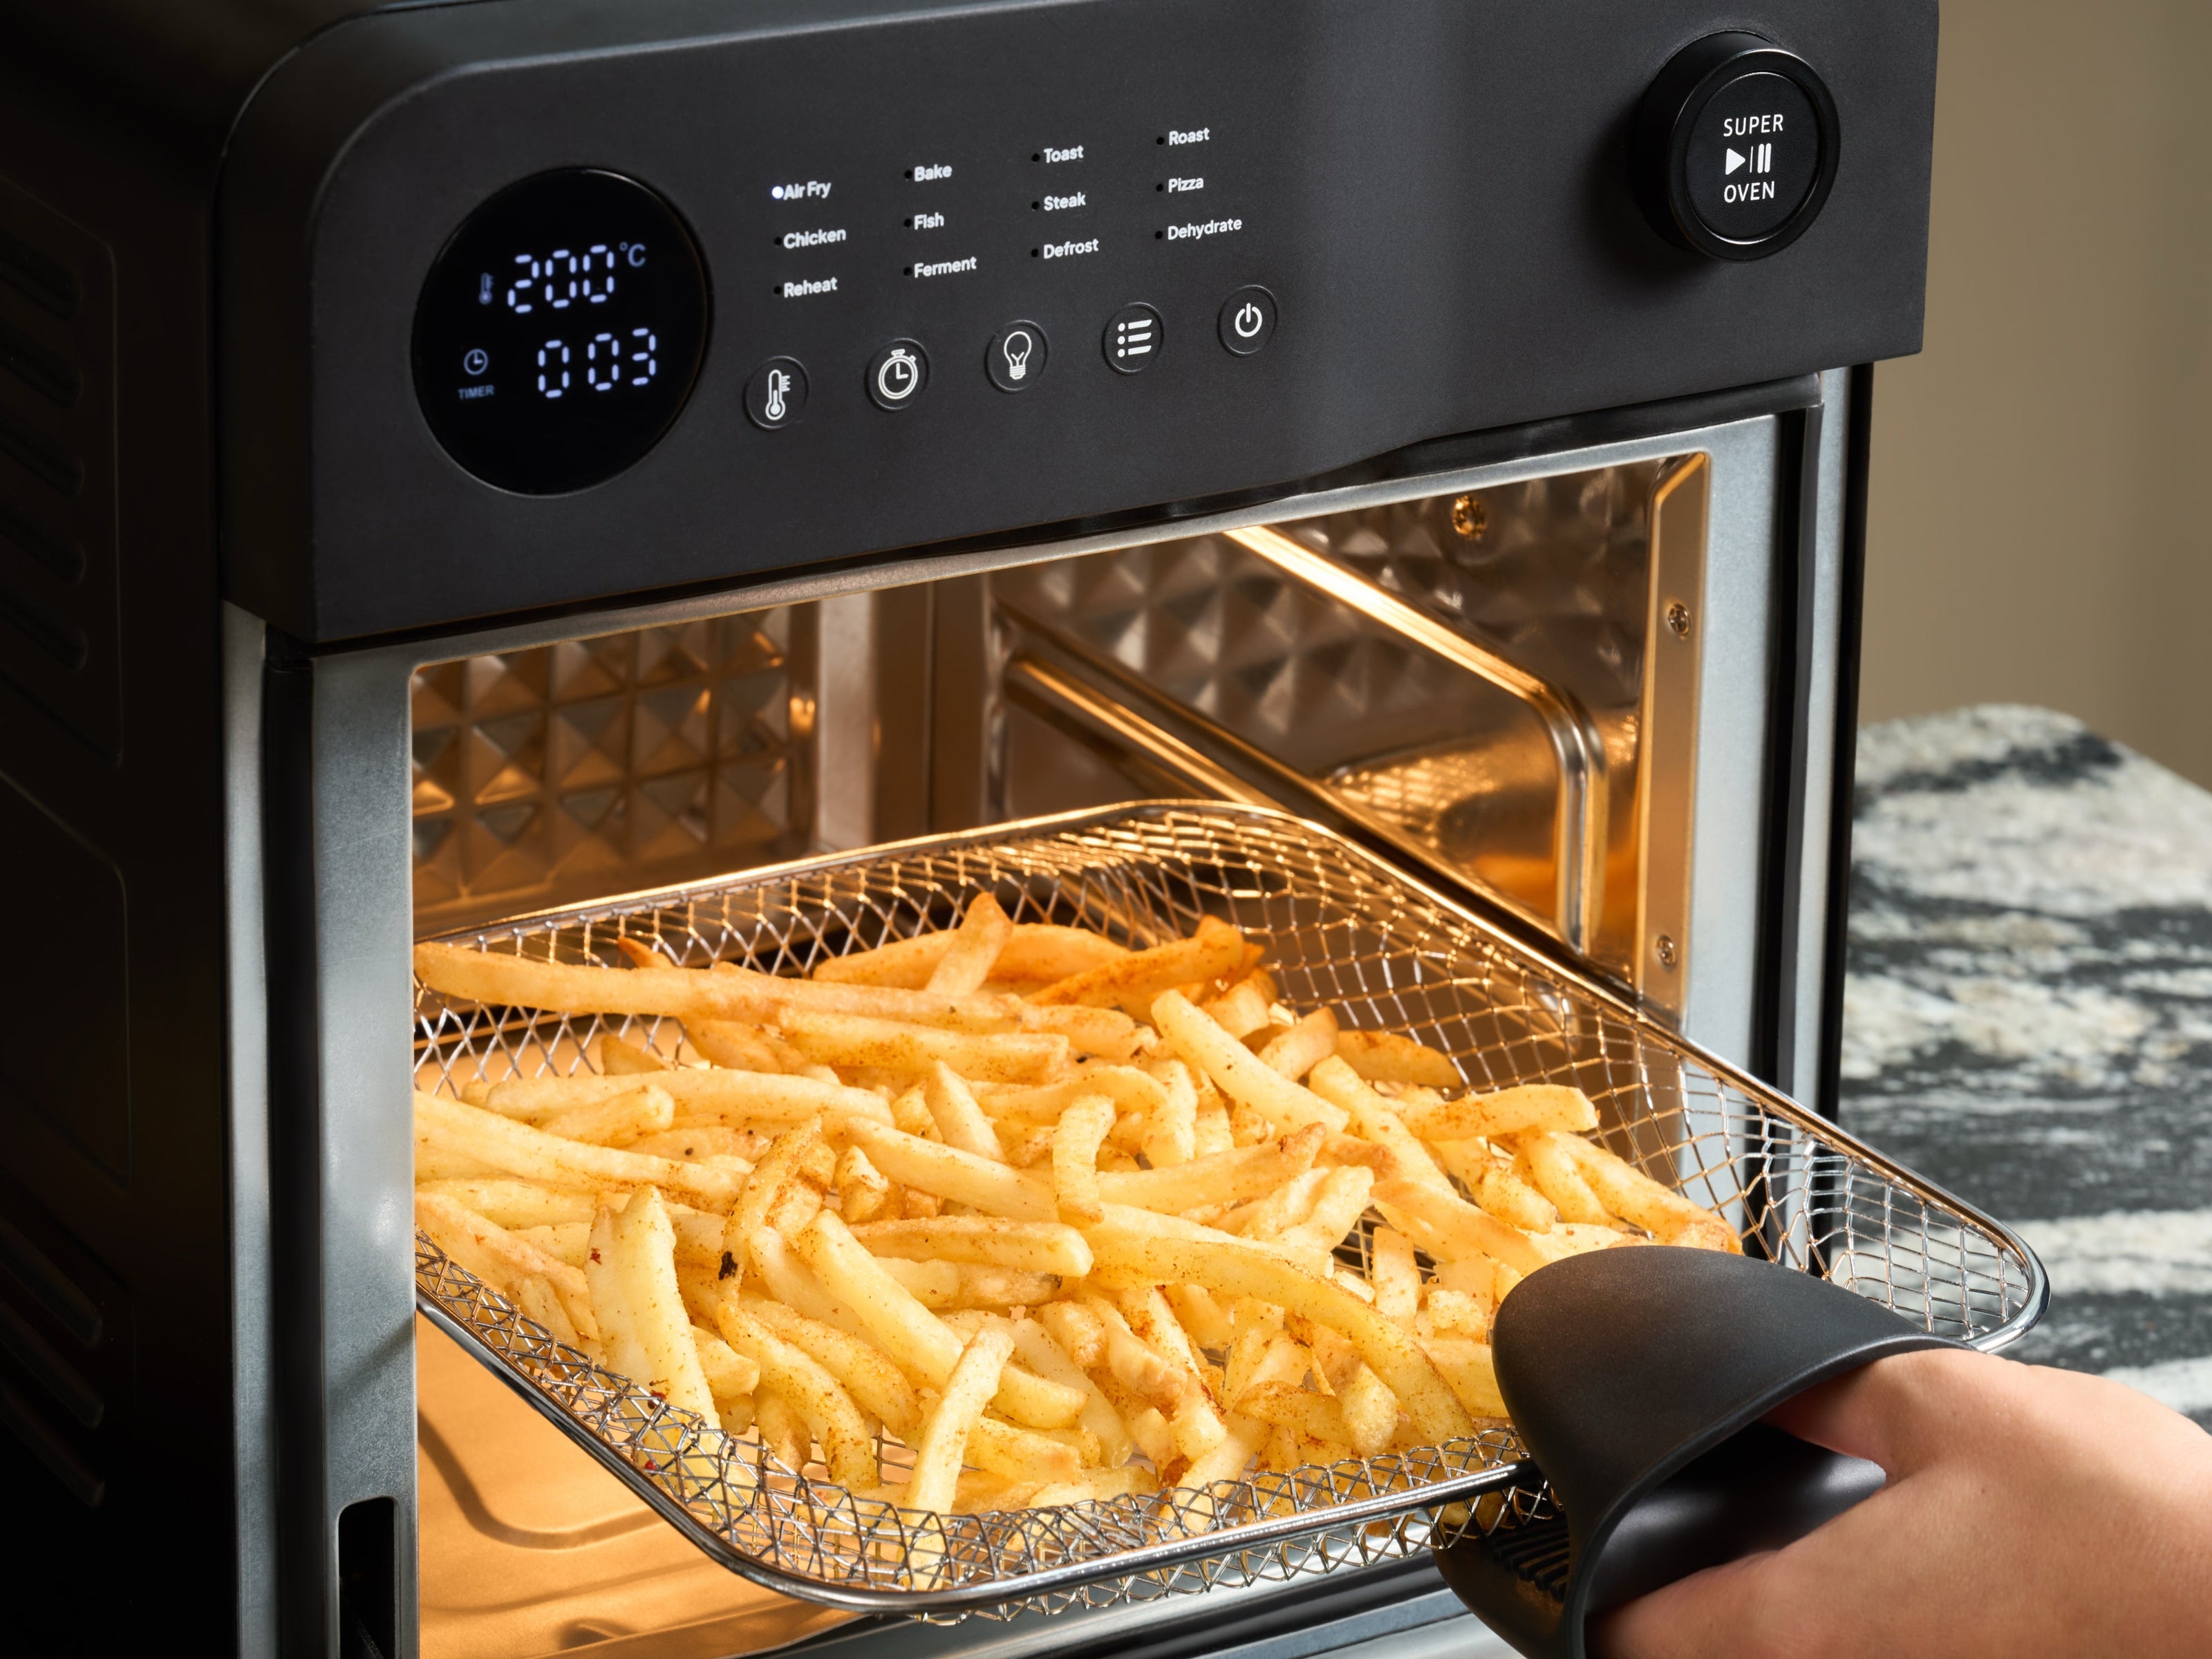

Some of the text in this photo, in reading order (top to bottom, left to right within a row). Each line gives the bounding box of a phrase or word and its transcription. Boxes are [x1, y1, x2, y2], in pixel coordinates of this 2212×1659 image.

[1723, 113, 1783, 137] SUPER
[1168, 127, 1210, 146] Roast
[1044, 145, 1084, 163] Toast
[914, 164, 953, 182] Bake
[783, 180, 831, 200] Air Fry
[1168, 176, 1204, 193] Pizza
[1723, 180, 1775, 203] OVEN
[1044, 191, 1086, 211] Steak
[914, 212, 944, 230] Fish
[1168, 218, 1242, 240] Dehydrate
[783, 229, 846, 249] Chicken
[1043, 238, 1098, 259] Defrost
[914, 256, 977, 278] Ferment
[784, 277, 838, 298] Reheat
[538, 328, 656, 397] 003
[458, 384, 494, 400] TIMER
